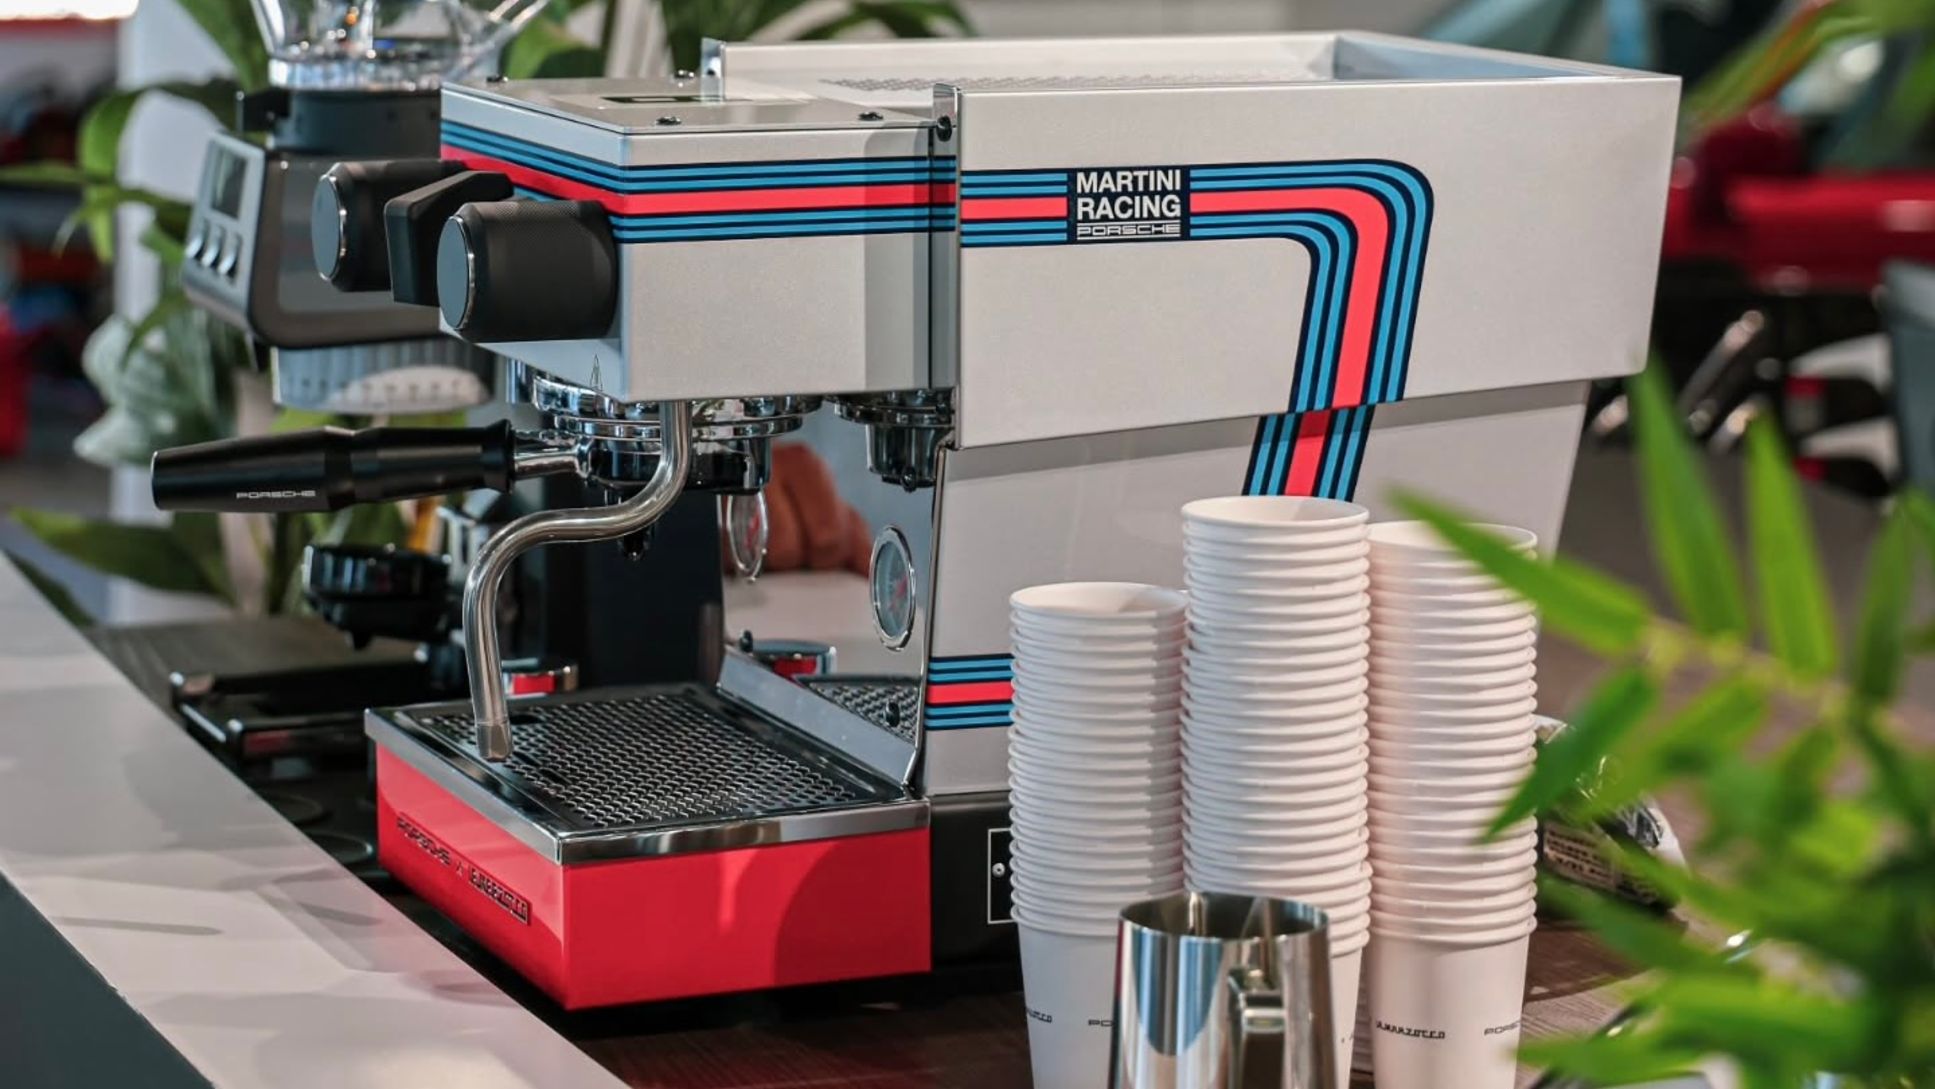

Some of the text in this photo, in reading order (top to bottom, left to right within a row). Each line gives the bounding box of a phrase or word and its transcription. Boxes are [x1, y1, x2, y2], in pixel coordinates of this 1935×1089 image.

[1076, 169, 1181, 193] MARTINI
[1077, 194, 1181, 220] RACING
[1077, 223, 1181, 236] PORSCHE
